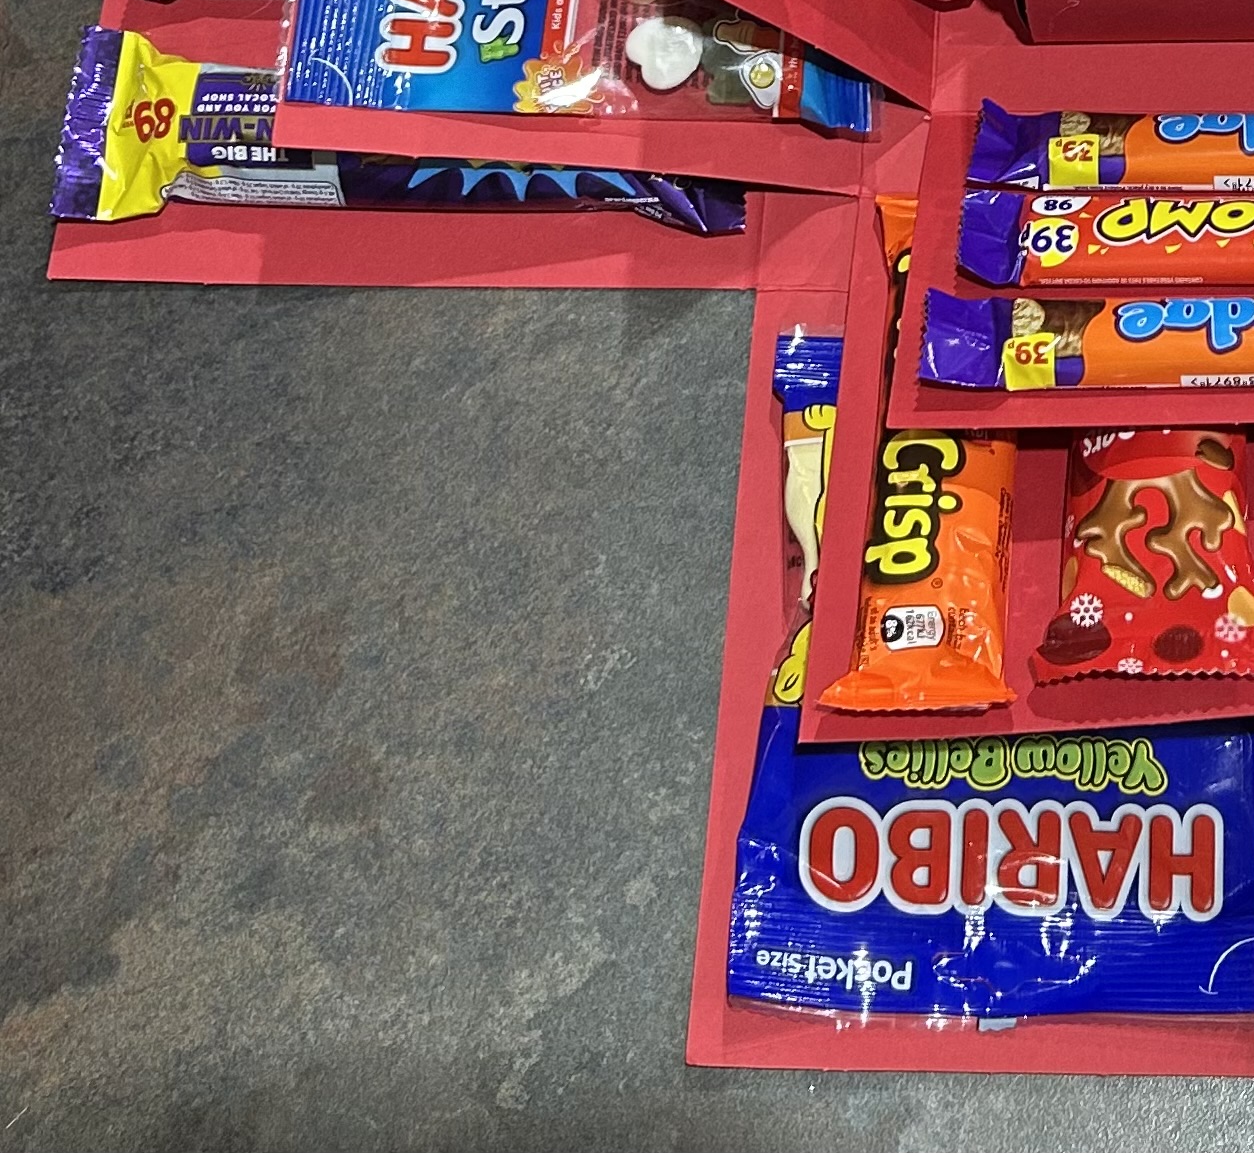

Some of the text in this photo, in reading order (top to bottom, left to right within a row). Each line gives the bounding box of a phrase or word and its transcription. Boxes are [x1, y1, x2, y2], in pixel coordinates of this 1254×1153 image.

[196, 103, 222, 114] AND
[200, 92, 235, 102] SHOP
[224, 103, 250, 113] YOU
[180, 116, 272, 142] N-WIN
[211, 145, 289, 163] THE BIG
[1043, 199, 1073, 211] 98
[1020, 221, 1075, 254] 39p
[1007, 340, 1050, 365] 39p
[866, 432, 962, 577] Crisp
[926, 610, 938, 641] Energy
[860, 736, 1168, 796] Yellow Bellies
[800, 797, 1223, 922] HARIBO
